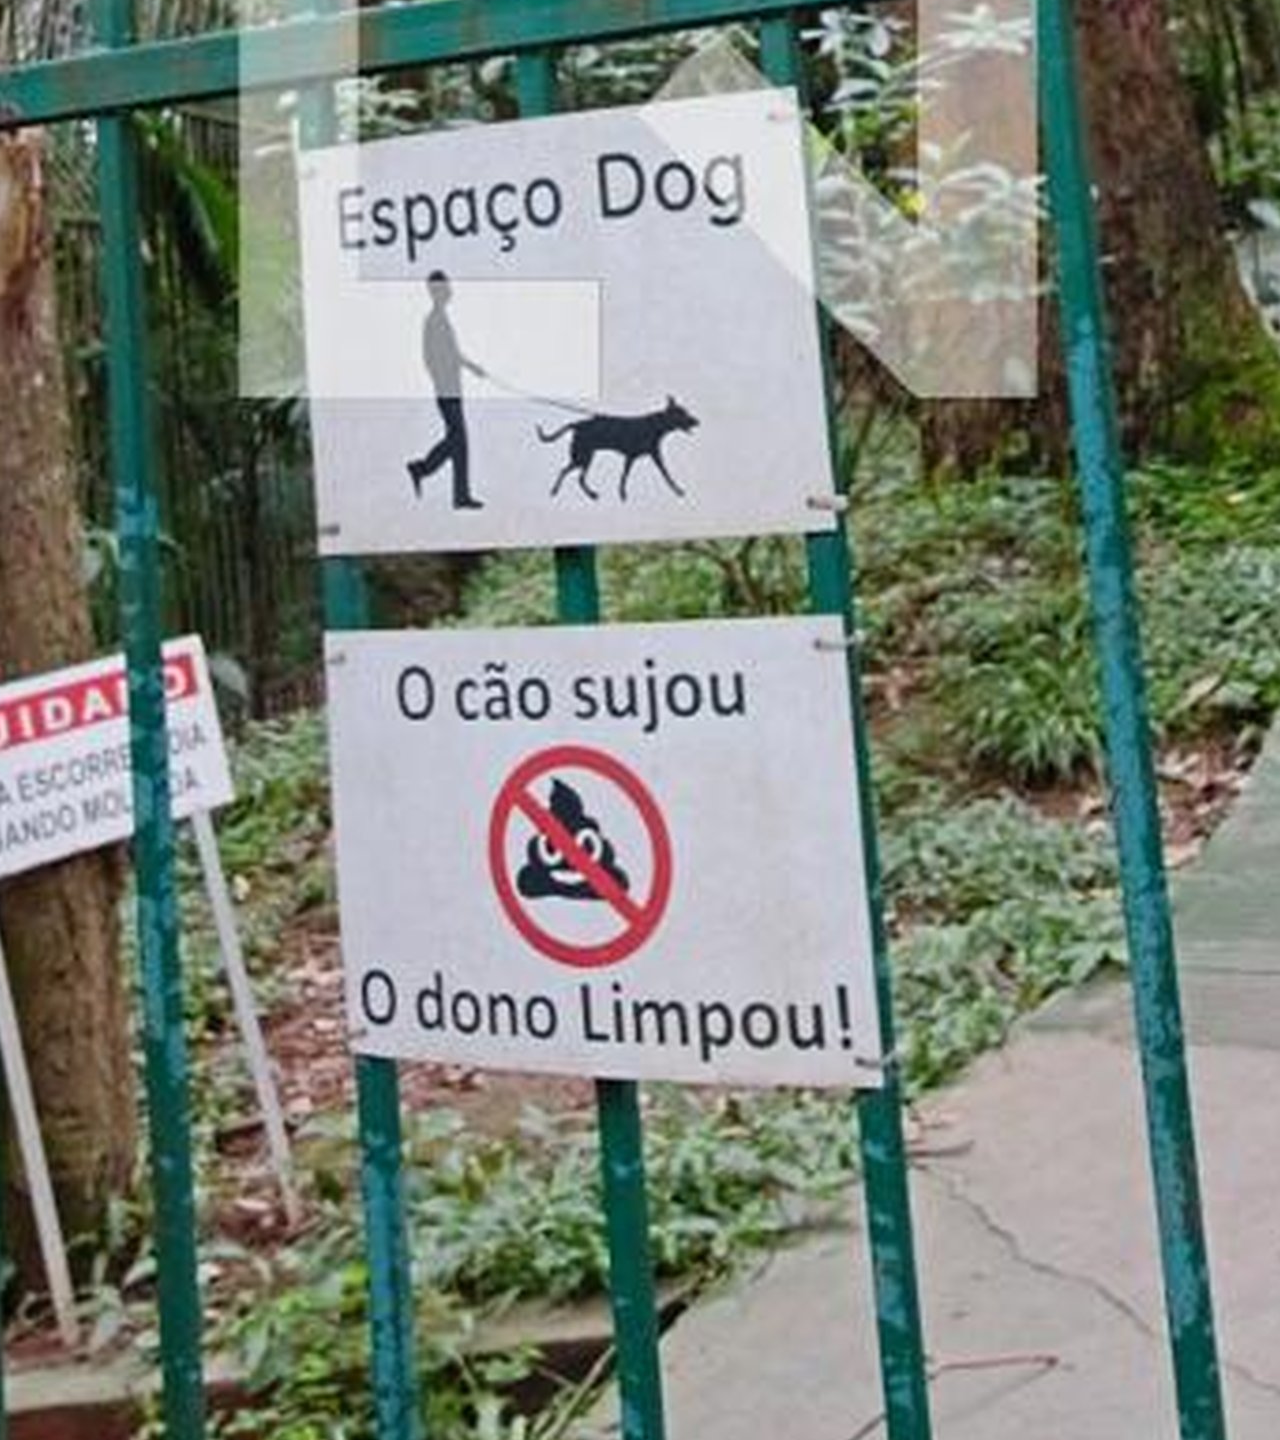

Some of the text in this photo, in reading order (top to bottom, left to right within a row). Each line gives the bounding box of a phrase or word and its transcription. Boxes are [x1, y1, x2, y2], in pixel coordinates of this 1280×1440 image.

[337, 152, 747, 262] Espaço Dog
[396, 659, 746, 734] O cão sujou
[360, 969, 854, 1063] O dono Limpou!
